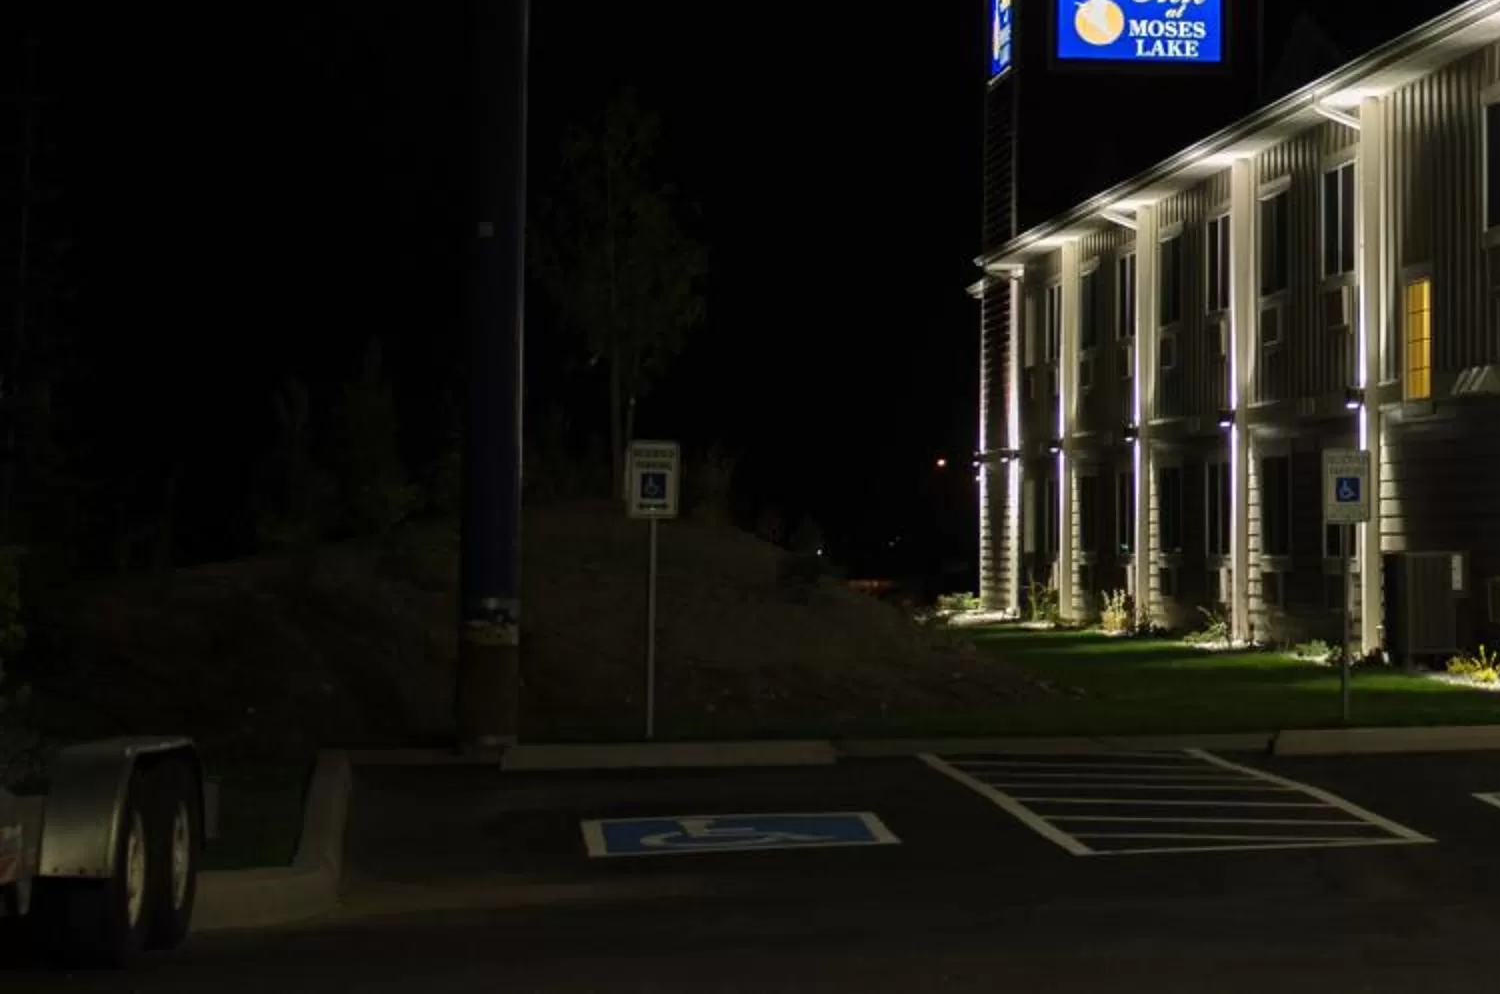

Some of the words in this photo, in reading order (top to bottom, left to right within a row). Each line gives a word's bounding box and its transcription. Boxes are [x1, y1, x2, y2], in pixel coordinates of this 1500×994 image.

[1165, 3, 1187, 18] at
[1128, 19, 1207, 39] MOSES
[1136, 39, 1200, 57] LAKE
